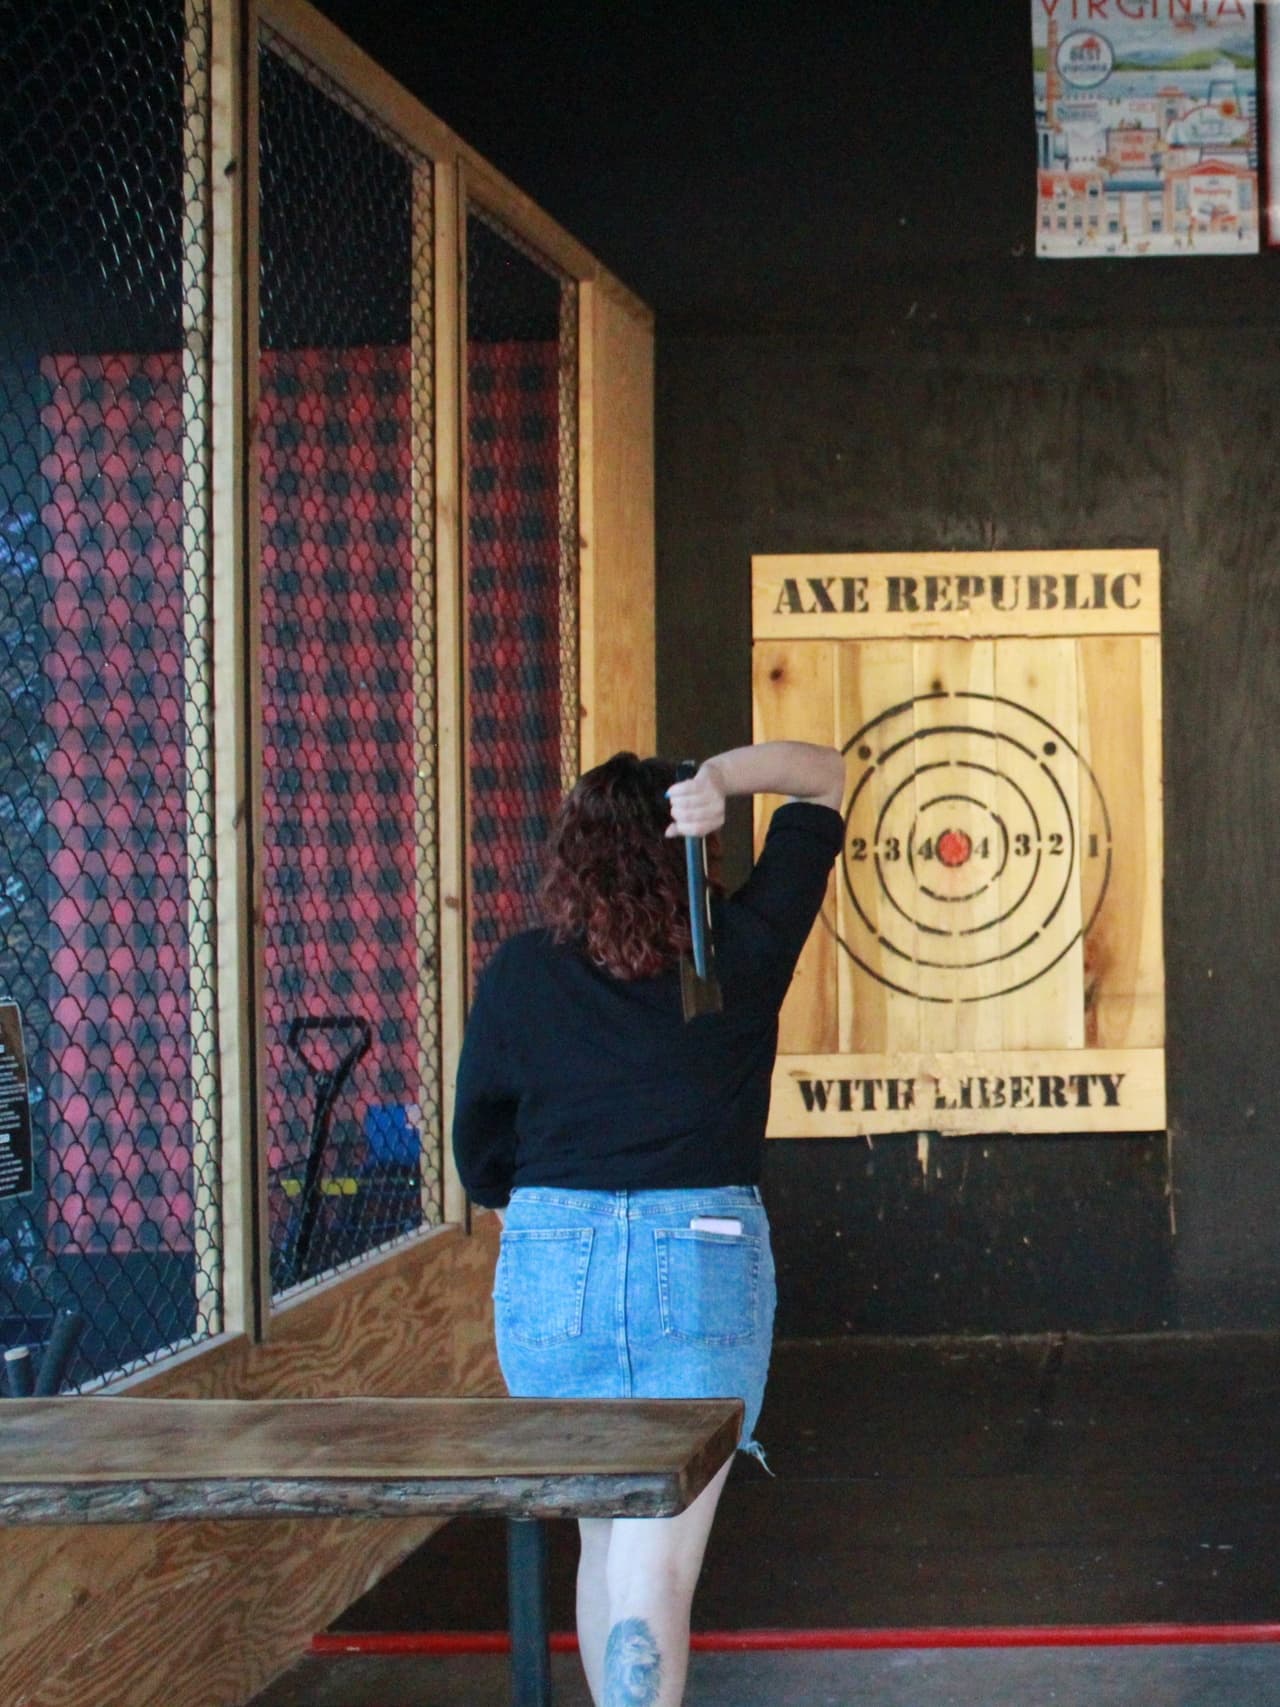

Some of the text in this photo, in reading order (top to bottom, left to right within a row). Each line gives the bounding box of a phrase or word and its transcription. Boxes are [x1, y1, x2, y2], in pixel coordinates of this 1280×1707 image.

[1041, 0, 1246, 20] VIRGINIA
[773, 572, 1142, 615] AXE REPUBLIC
[851, 838, 868, 861] 2
[884, 837, 900, 860] 3
[917, 837, 933, 860] 4
[1014, 833, 1031, 857] 3
[1048, 833, 1064, 855] 2
[1088, 834, 1099, 858] 1
[797, 1072, 1126, 1112] WITH LIBERTY
